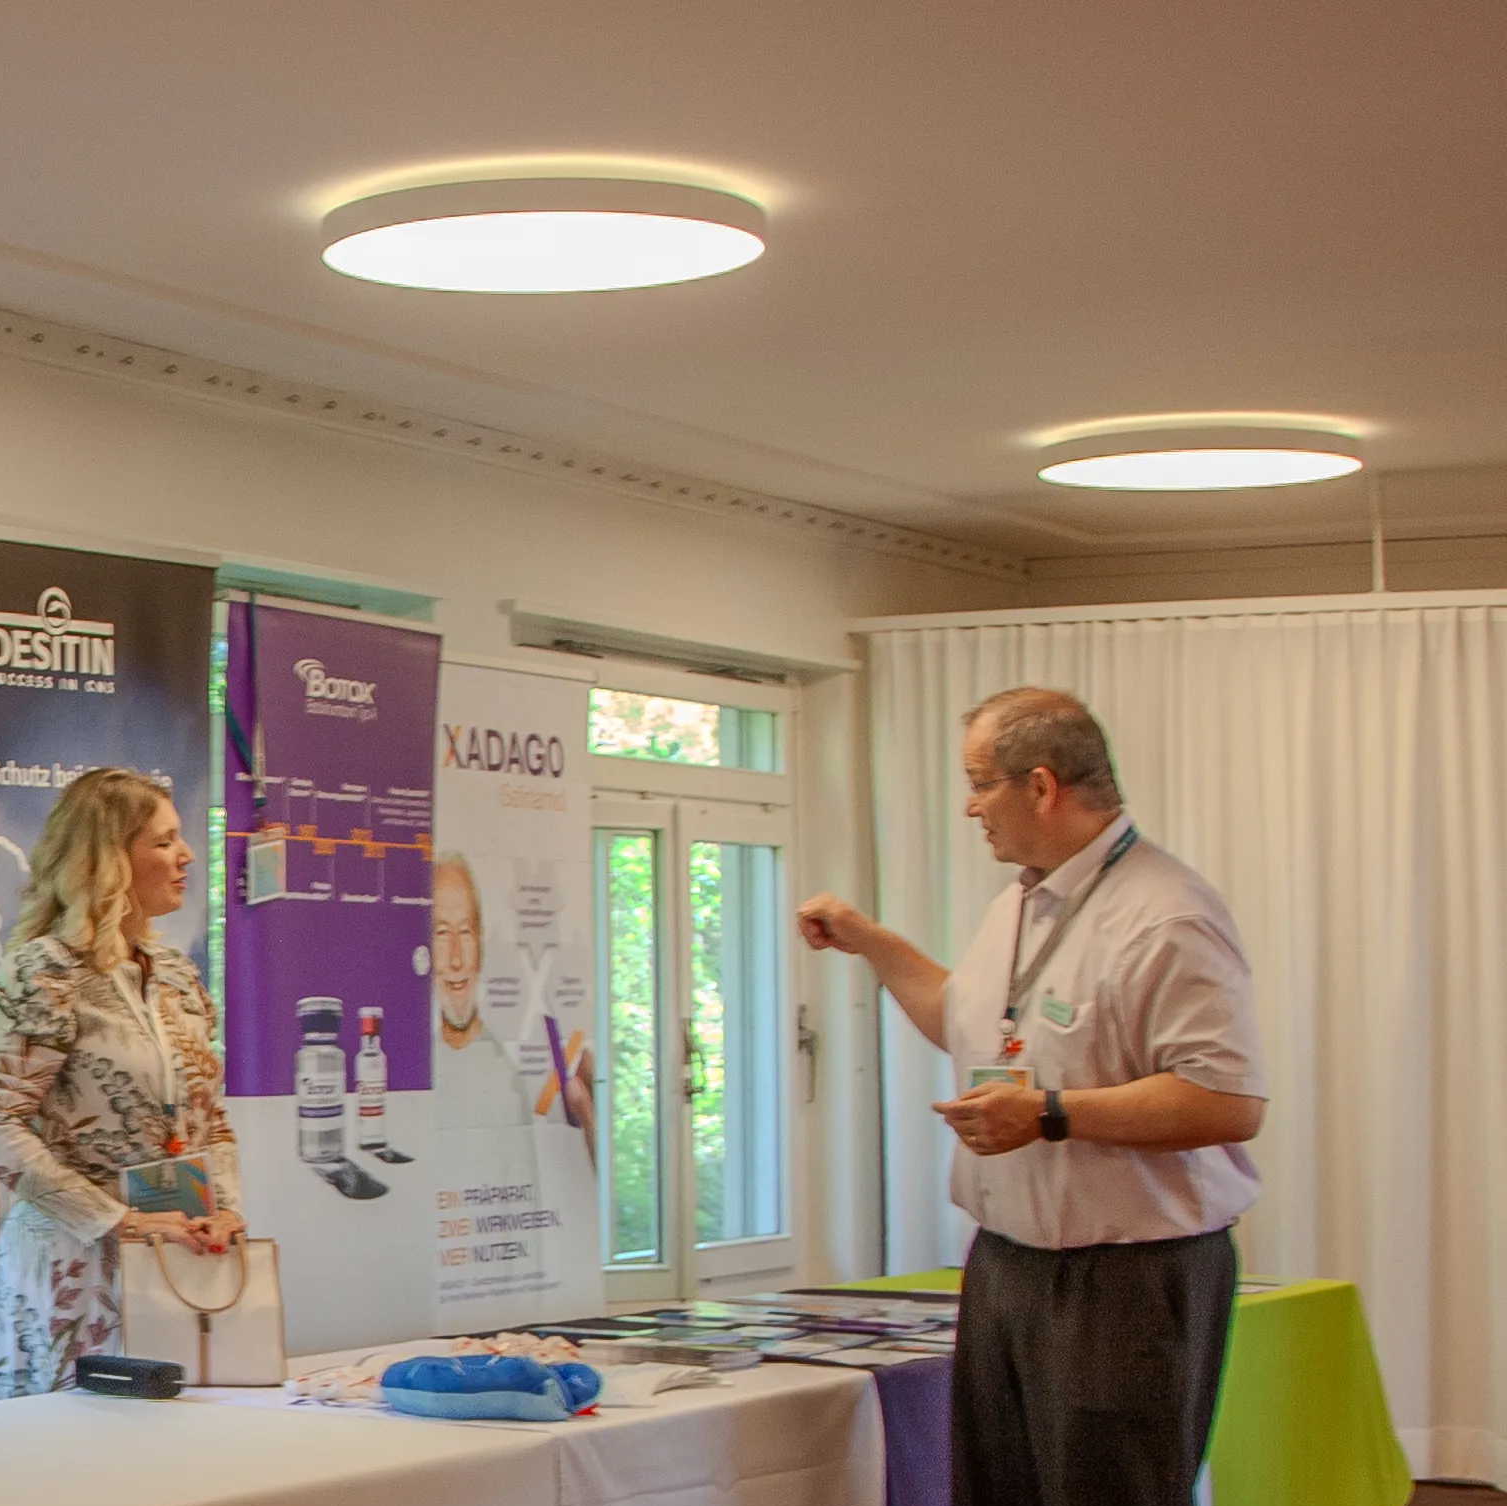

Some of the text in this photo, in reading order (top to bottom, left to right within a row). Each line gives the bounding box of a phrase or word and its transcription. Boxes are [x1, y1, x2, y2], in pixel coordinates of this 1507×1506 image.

[57, 677, 79, 691] IN
[83, 679, 116, 695] CNS
[443, 723, 564, 779] XADAGO
